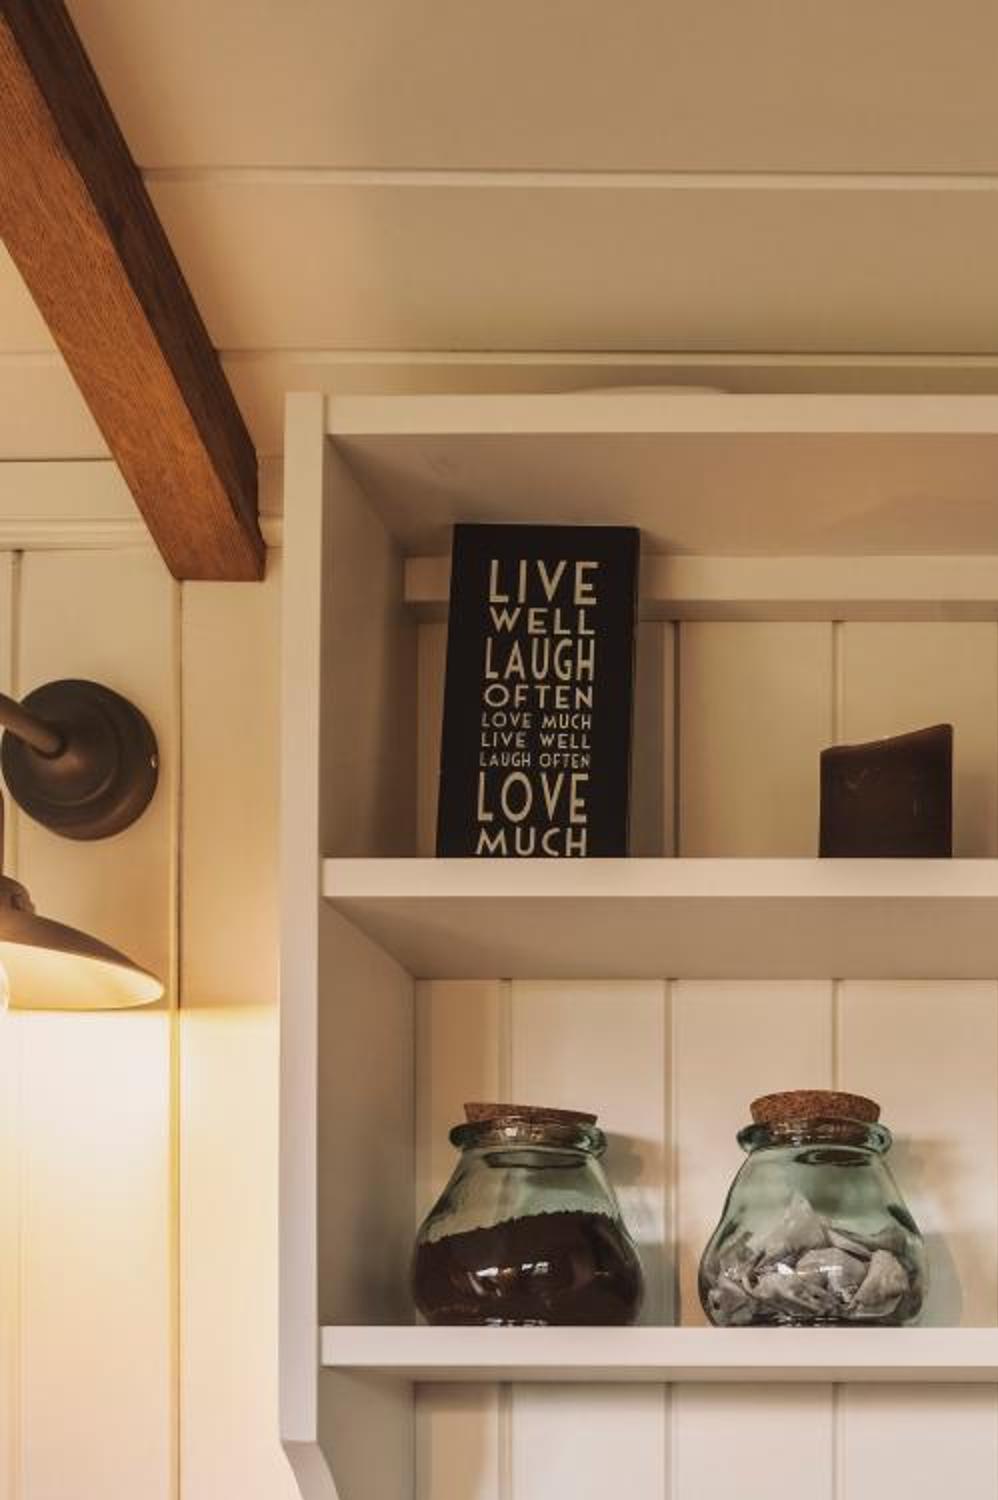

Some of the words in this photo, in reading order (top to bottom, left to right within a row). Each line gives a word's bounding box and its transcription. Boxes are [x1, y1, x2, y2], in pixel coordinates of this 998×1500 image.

[489, 559, 599, 605] LIVE
[490, 606, 595, 635] WELL
[485, 637, 595, 681] LAUGH
[484, 683, 593, 709] OFTEN
[481, 711, 532, 728] LOVE
[541, 713, 592, 729] MUCH
[481, 731, 527, 748] LIVE
[539, 733, 591, 749] WELL
[479, 751, 532, 767] LAUGH
[539, 753, 591, 768] OFTEN
[477, 771, 589, 823] LOVE
[474, 826, 588, 857] MUCH
